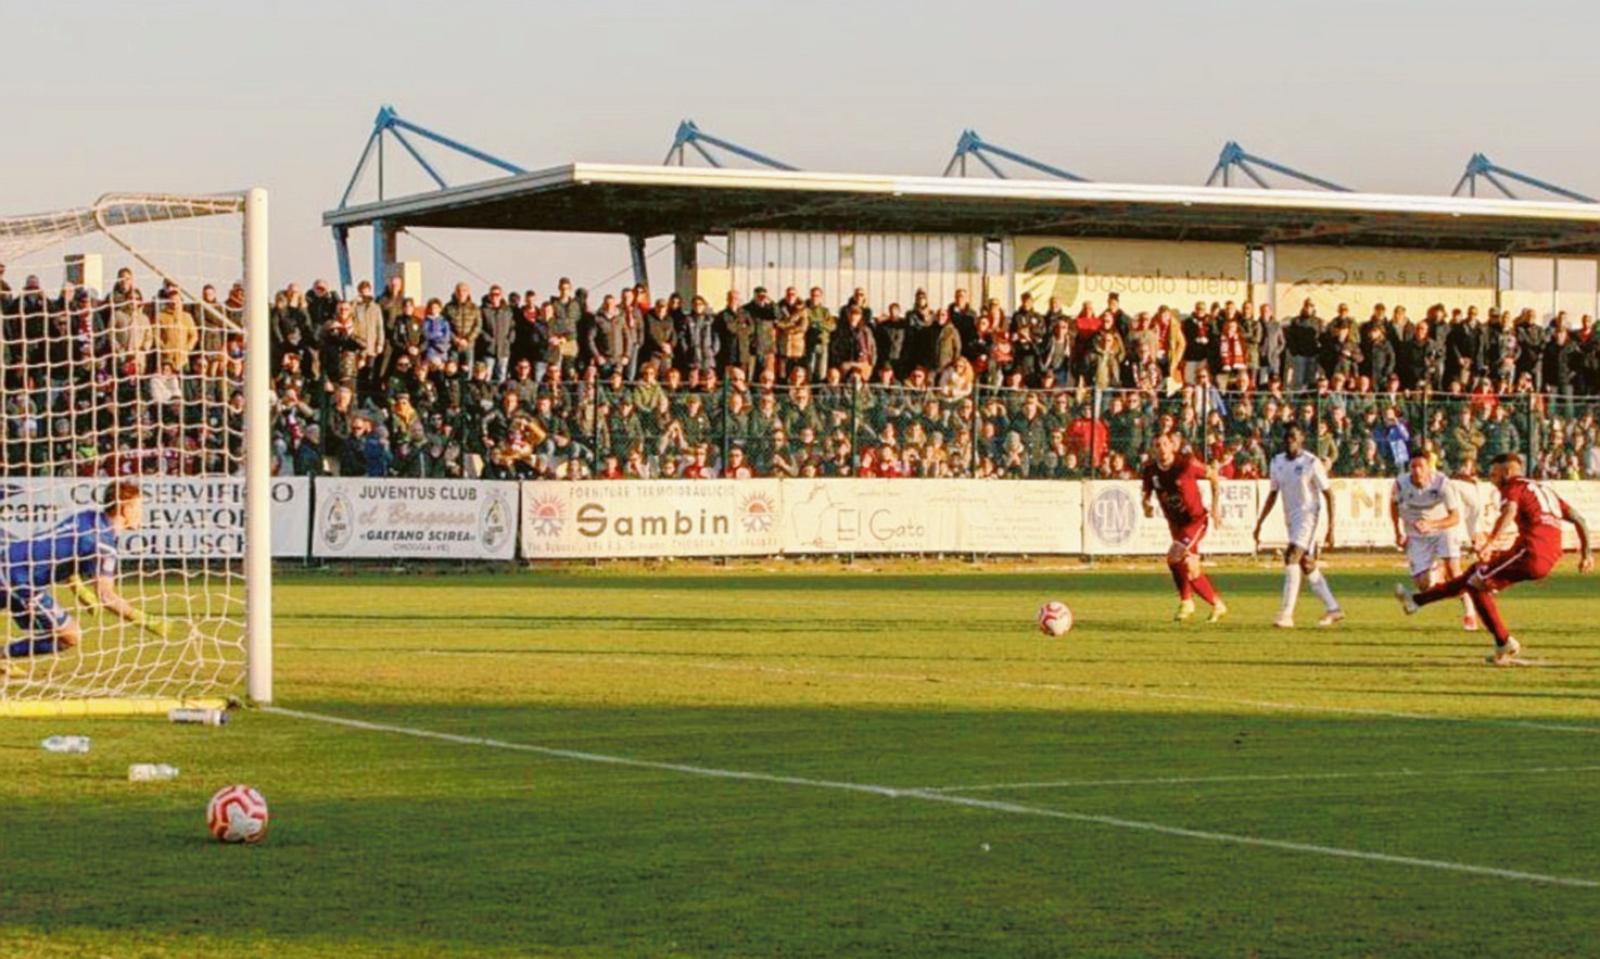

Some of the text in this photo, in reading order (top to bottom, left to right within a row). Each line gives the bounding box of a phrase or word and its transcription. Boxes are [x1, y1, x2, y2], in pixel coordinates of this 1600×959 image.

[1084, 267, 1178, 295] boscolo
[1352, 270, 1488, 286] MOSELLA
[358, 485, 478, 502] JUVENTUS CLUB
[576, 502, 730, 539] Sambin
[837, 508, 925, 541] El Gato
[117, 534, 244, 555] OLLUSC
